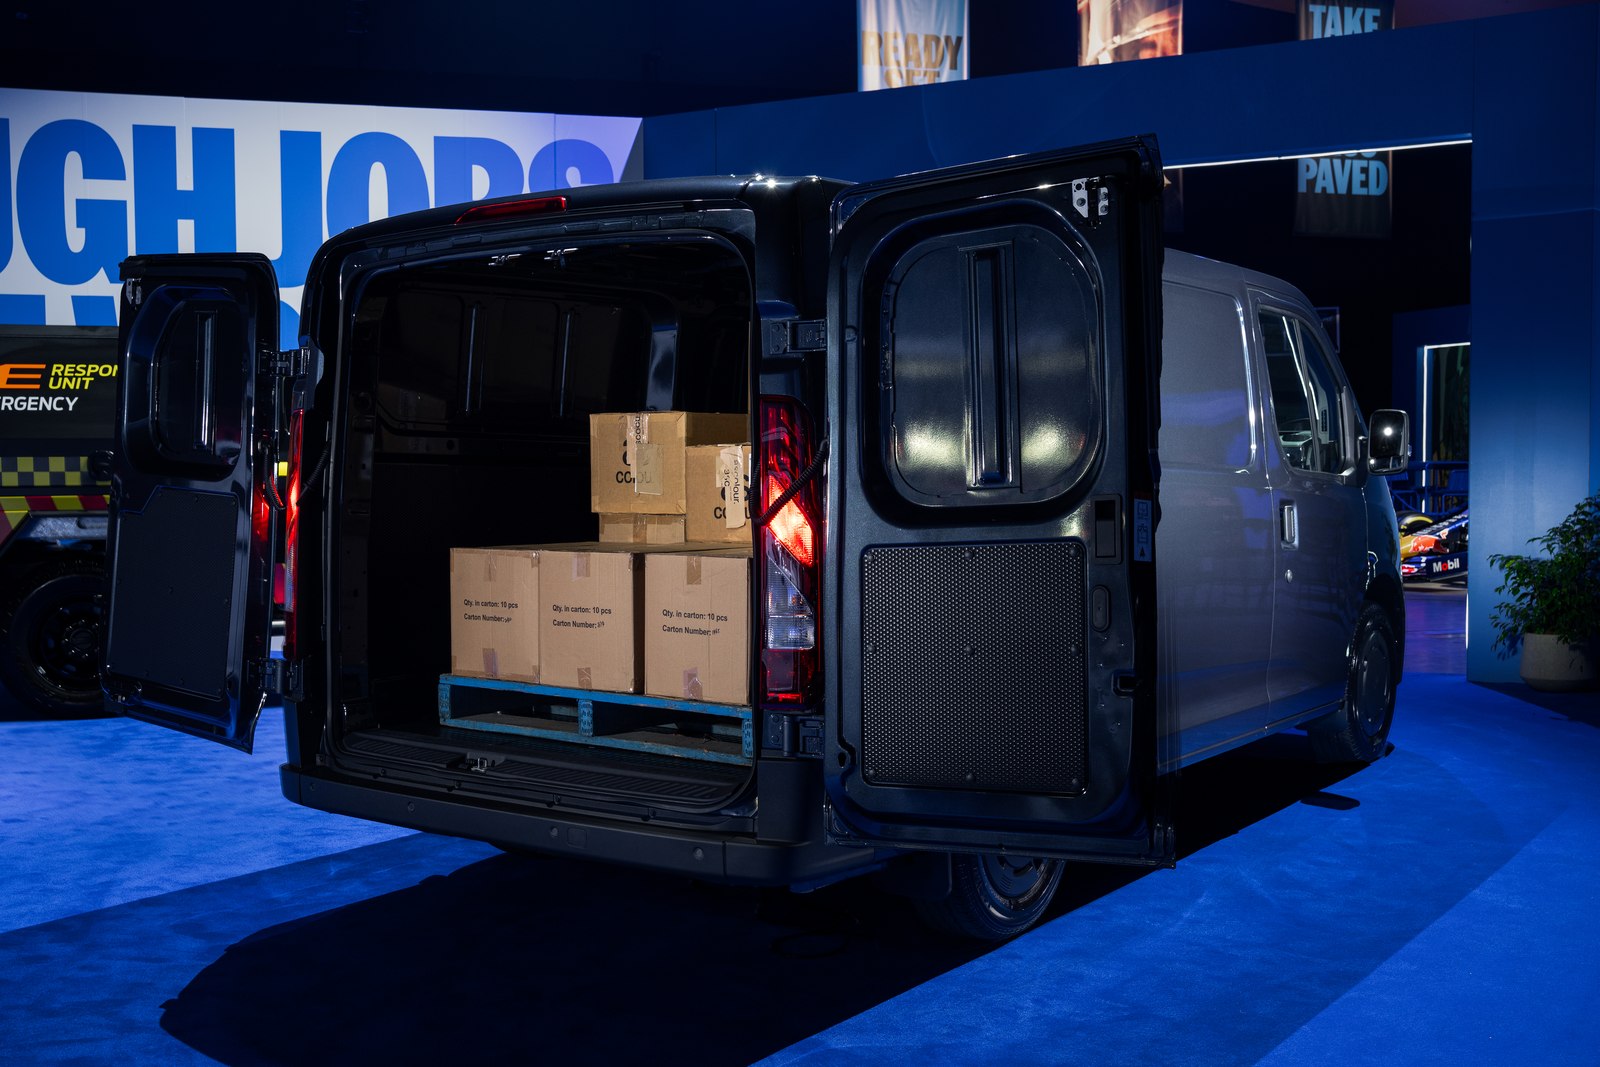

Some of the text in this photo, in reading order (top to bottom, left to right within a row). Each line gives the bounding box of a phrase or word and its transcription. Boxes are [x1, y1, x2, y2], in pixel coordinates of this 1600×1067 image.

[1309, 4, 1381, 39] TAKE
[861, 31, 963, 71] READY
[1299, 157, 1389, 196] PAVED
[0, 117, 235, 286] GH
[48, 377, 94, 389] UNIT
[0, 396, 78, 411] RGENCY
[1433, 558, 1460, 573] Mobil
[552, 604, 564, 614] Qty.
[593, 606, 600, 614] 10
[601, 608, 612, 616] pcs
[662, 609, 674, 619] Qty.
[683, 612, 706, 620] carton:
[708, 613, 715, 621] 10
[463, 613, 482, 621] Carton
[552, 619, 572, 627] Carton
[572, 620, 597, 629] Number:
[662, 624, 683, 633] Carton
[684, 626, 711, 636] Number:
